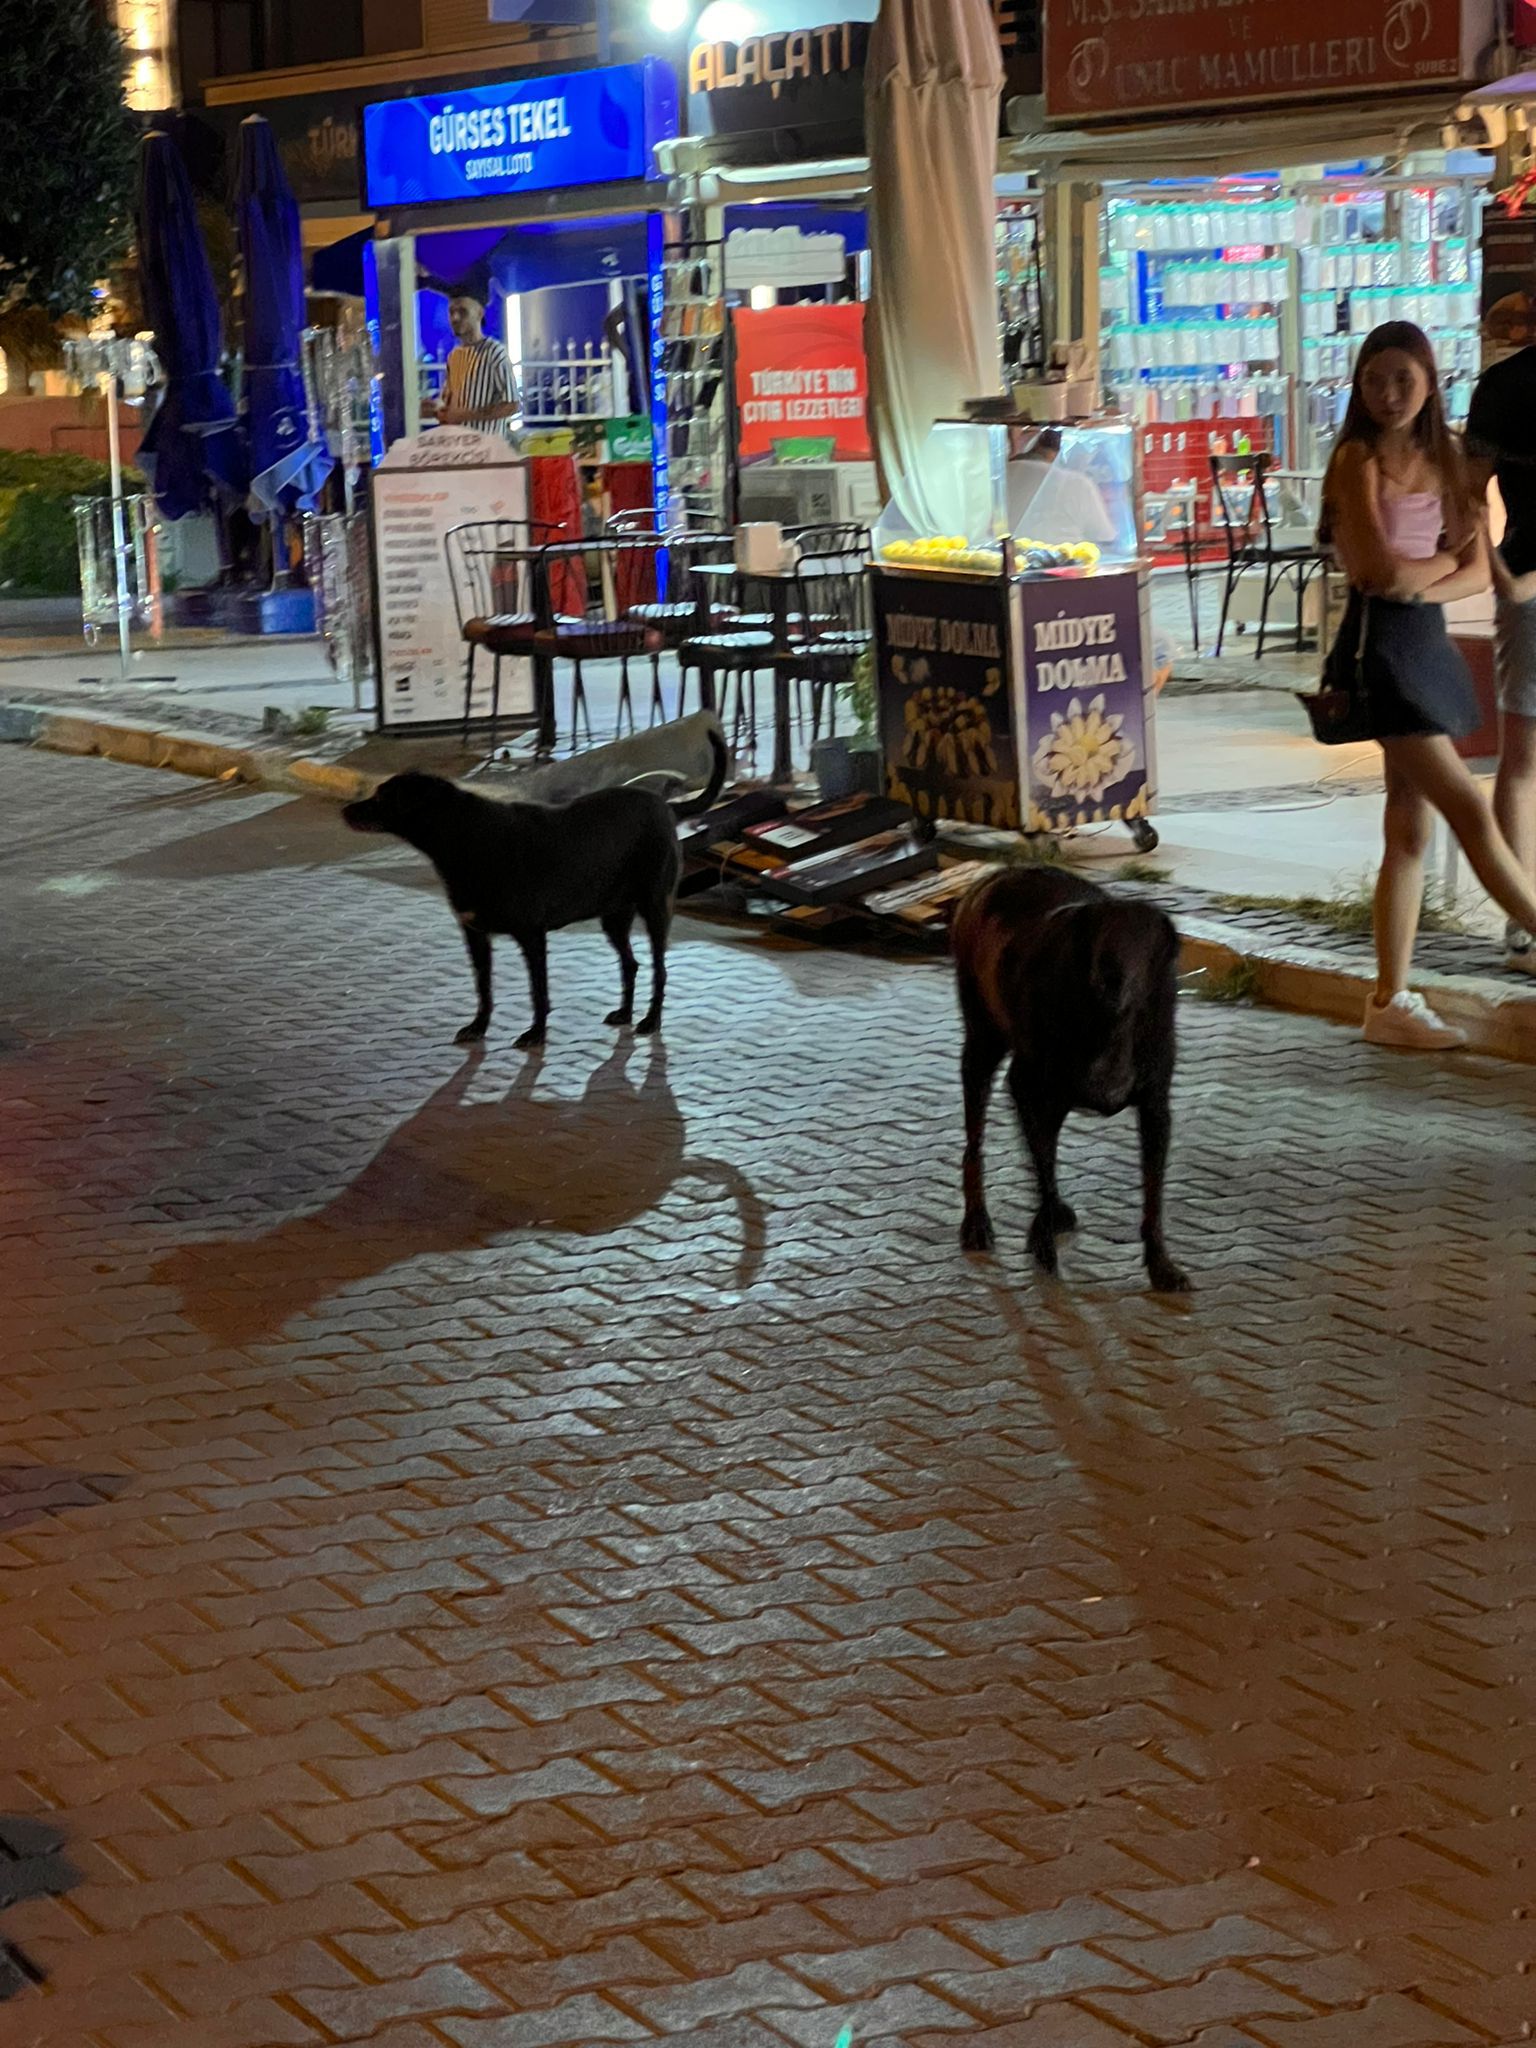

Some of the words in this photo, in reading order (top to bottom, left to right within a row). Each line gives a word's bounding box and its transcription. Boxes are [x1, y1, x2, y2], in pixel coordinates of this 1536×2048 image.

[689, 22, 851, 99] ALAÇATI
[429, 105, 506, 154] GÜRSES
[507, 96, 571, 144] TEKEL
[1034, 610, 1116, 652] MİDYE
